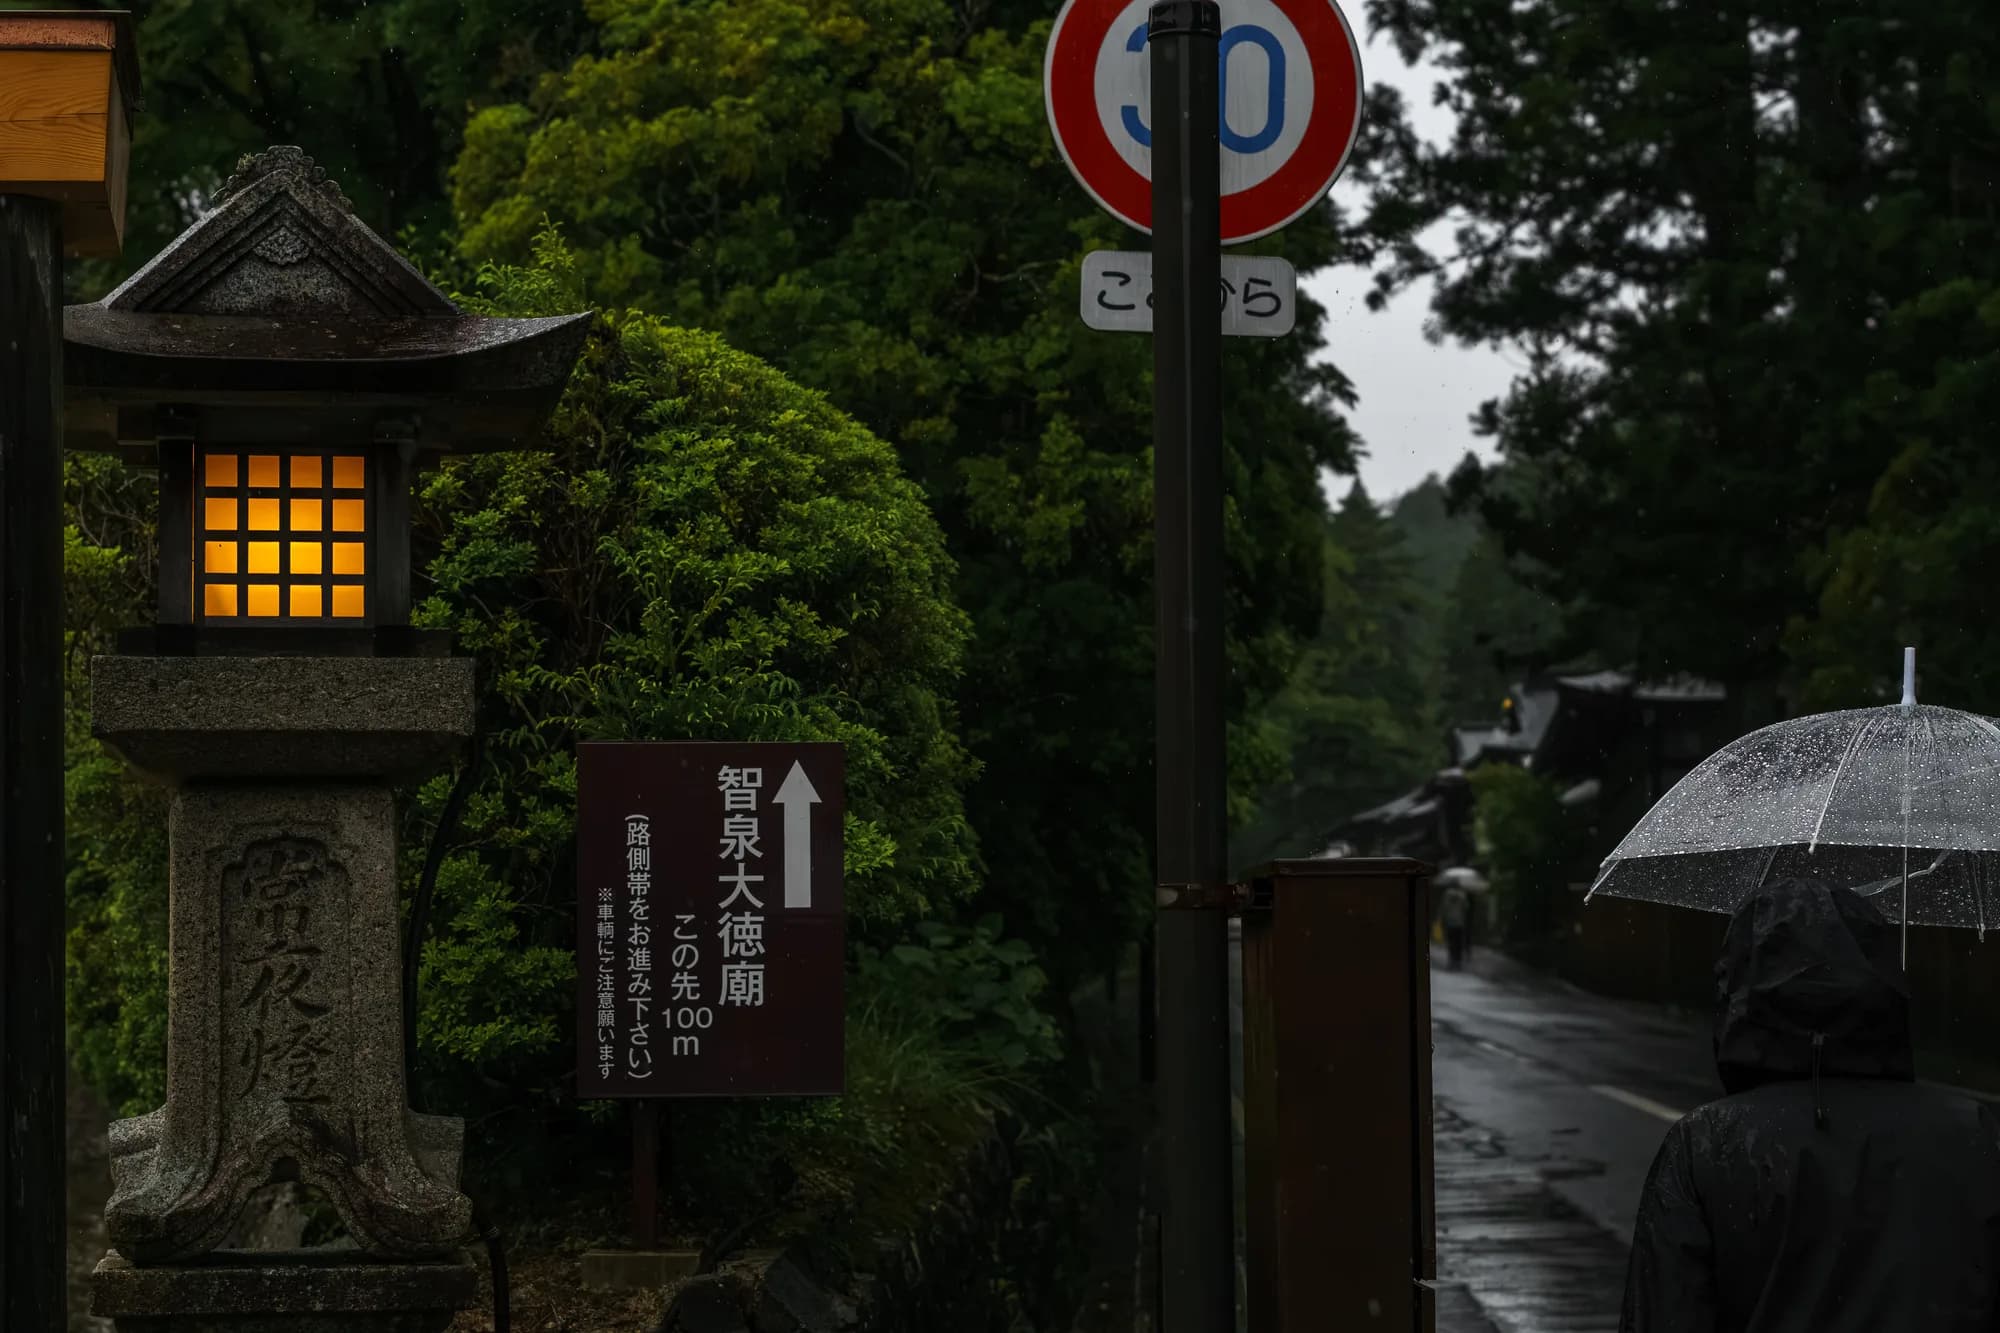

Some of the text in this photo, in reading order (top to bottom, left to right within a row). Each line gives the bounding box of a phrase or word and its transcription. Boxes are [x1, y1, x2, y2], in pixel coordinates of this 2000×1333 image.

[718, 765, 765, 1007] 智泉大徳廟
